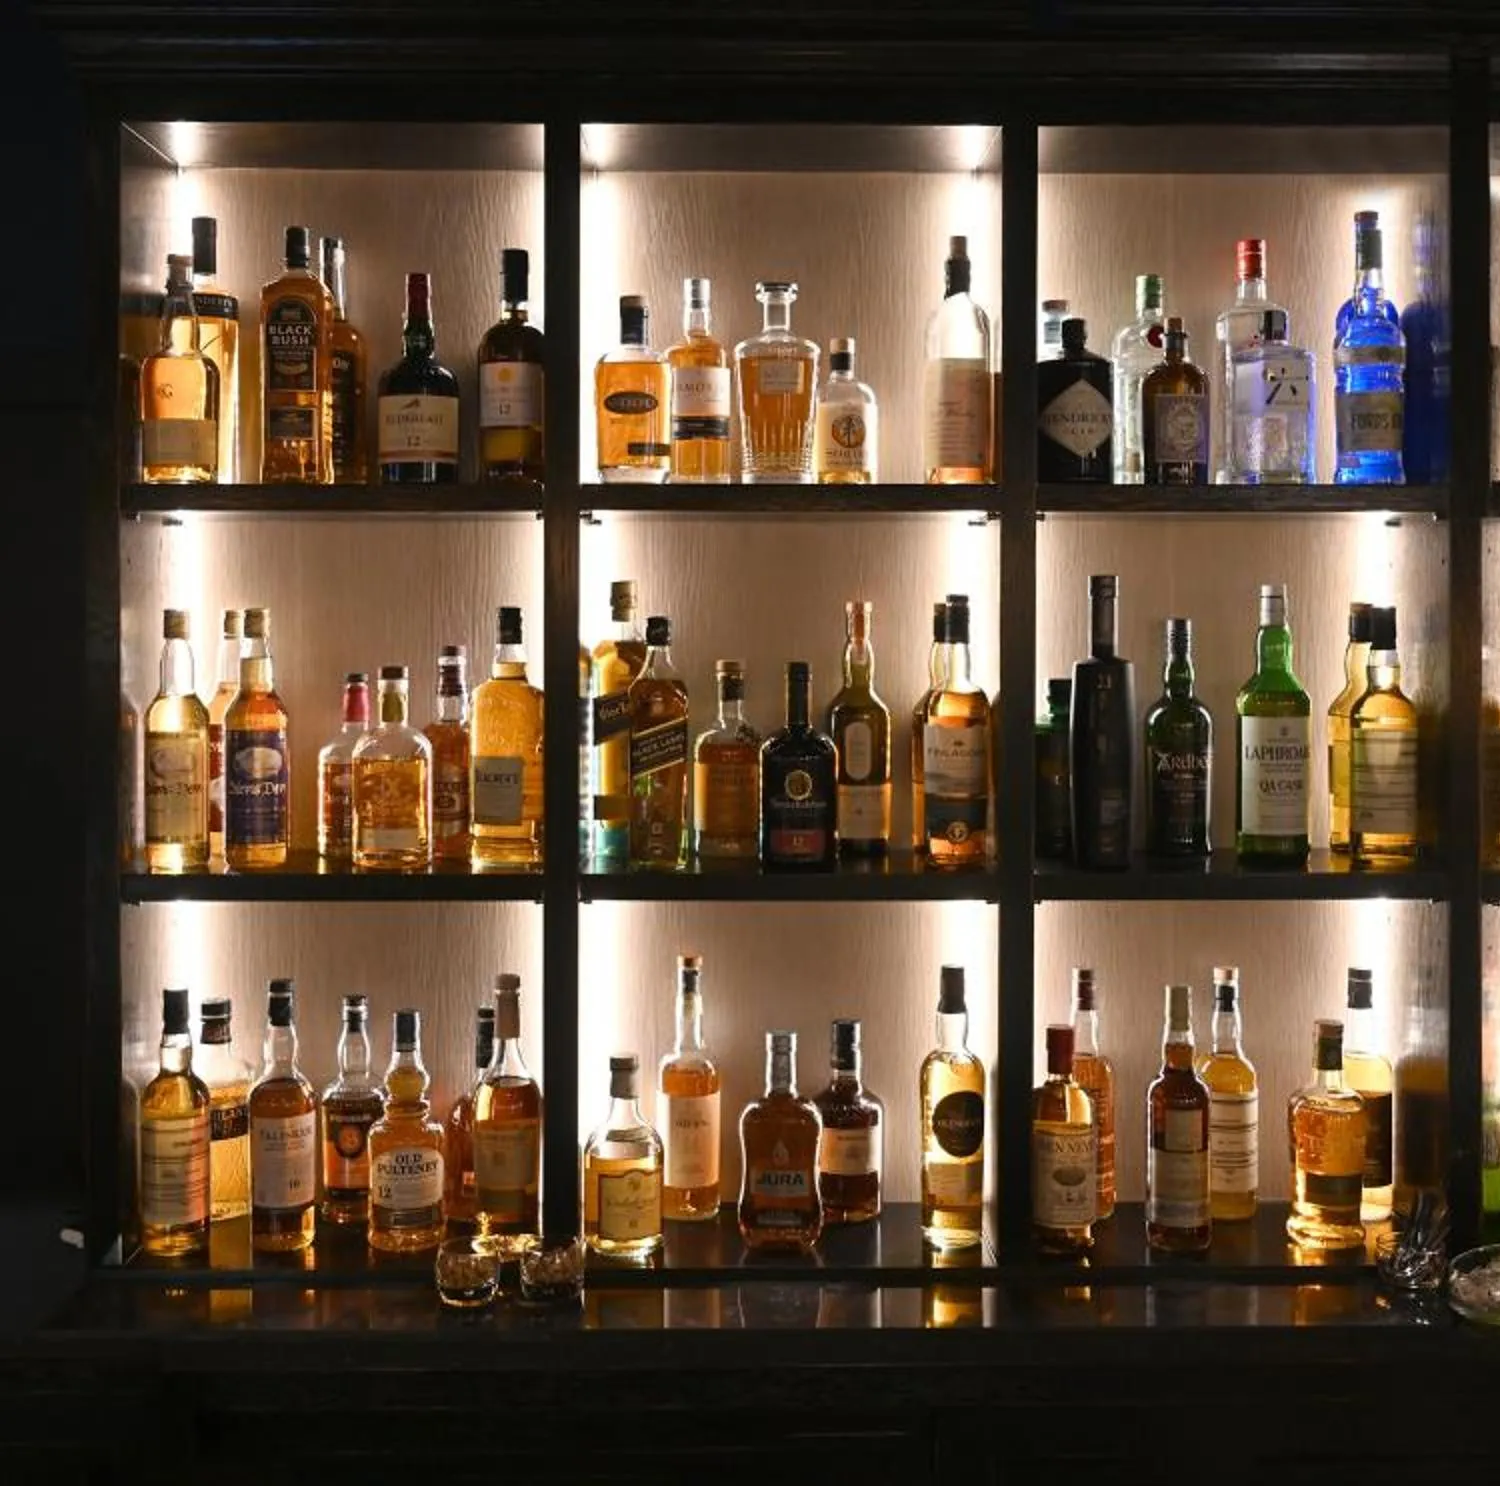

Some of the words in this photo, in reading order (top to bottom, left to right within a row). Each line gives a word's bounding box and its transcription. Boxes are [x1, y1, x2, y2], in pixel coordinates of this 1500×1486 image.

[268, 324, 312, 336] BLACK
[271, 335, 309, 346] BUSH
[407, 436, 420, 448] 12
[395, 1153, 423, 1163] OLD
[760, 1173, 805, 1186] JURA
[378, 1186, 393, 1199] 12
